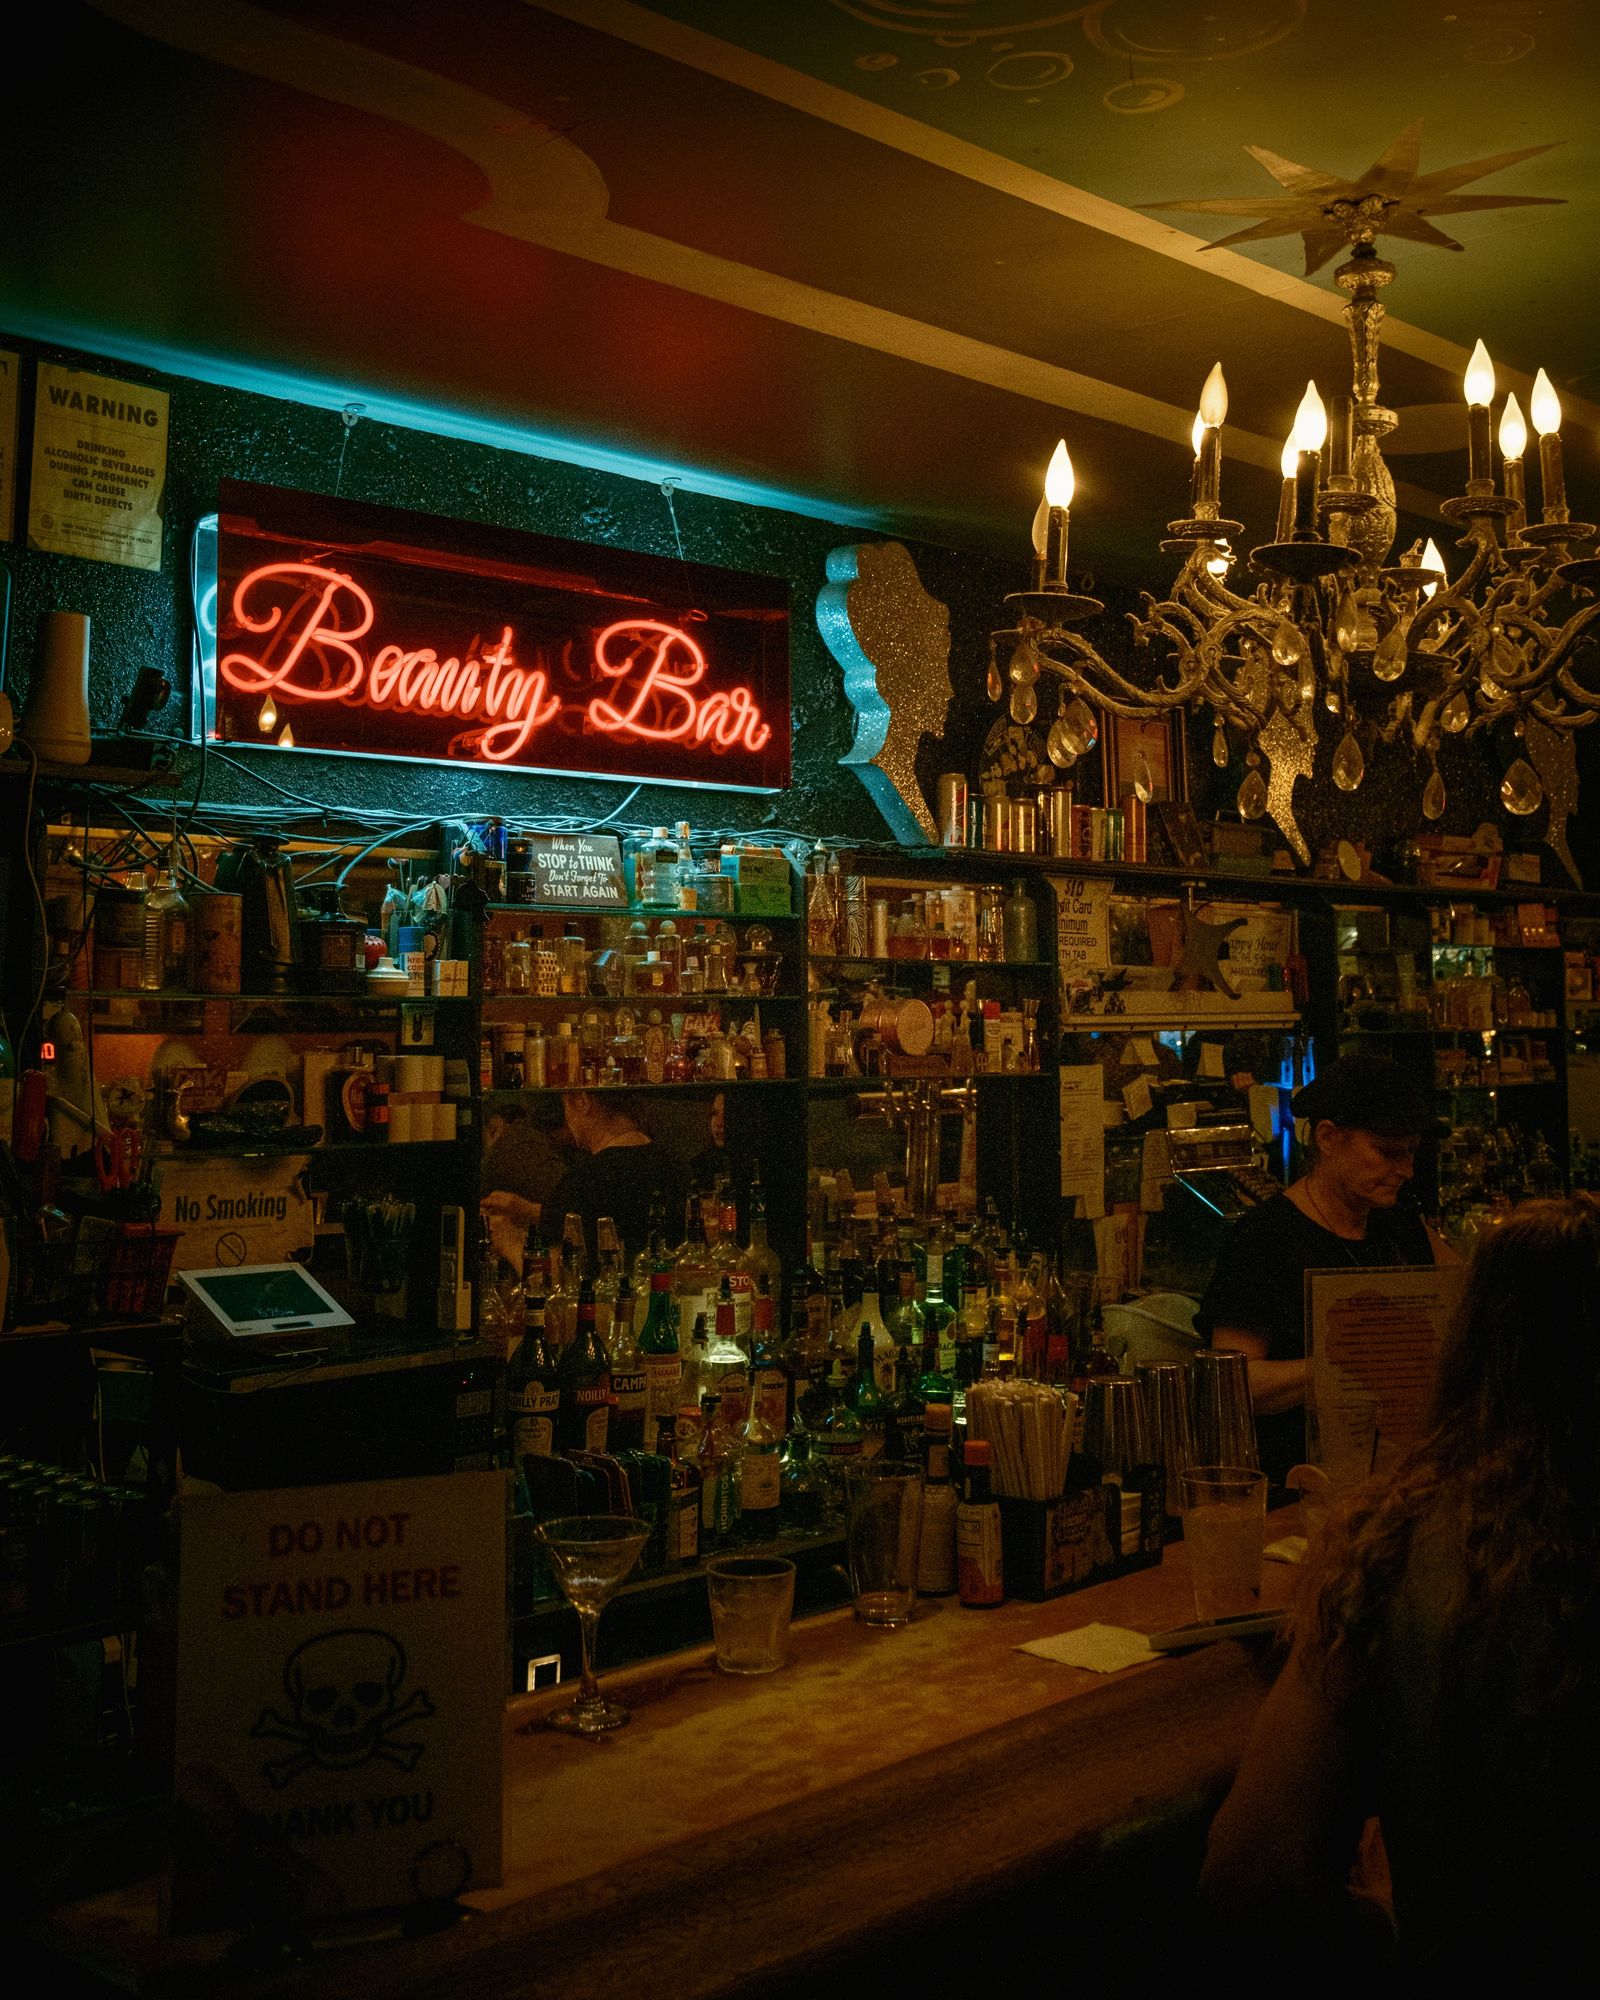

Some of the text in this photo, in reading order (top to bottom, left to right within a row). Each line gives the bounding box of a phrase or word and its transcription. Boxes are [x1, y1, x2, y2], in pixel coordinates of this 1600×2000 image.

[49, 385, 159, 427] WARNING
[77, 440, 126, 458] DRINKING
[44, 446, 155, 477] ALCOHOLIC BEVERAGES
[49, 460, 149, 489] DURING PREGNANCY
[72, 478, 125, 497] CAN CAUSE
[63, 489, 133, 511] BIRTH DEFECTS
[220, 561, 772, 761] Beauty Bar
[551, 836, 594, 853] When You
[538, 854, 616, 873] STOP to THINK
[549, 868, 609, 886] Don't Forget To
[543, 885, 619, 900] START AGAIN
[1073, 898, 1092, 914] Card
[1059, 936, 1097, 947] REQUIRED
[1072, 950, 1087, 960] TAB
[175, 1190, 288, 1223] No Smoking
[513, 1397, 537, 1408] OILLY
[577, 1388, 606, 1402] NOILLY
[720, 1474, 730, 1531] HORNITOS
[270, 1513, 411, 1557] DO NOT
[222, 1565, 463, 1621] STAND HERE
[368, 1792, 433, 1828] YOU
